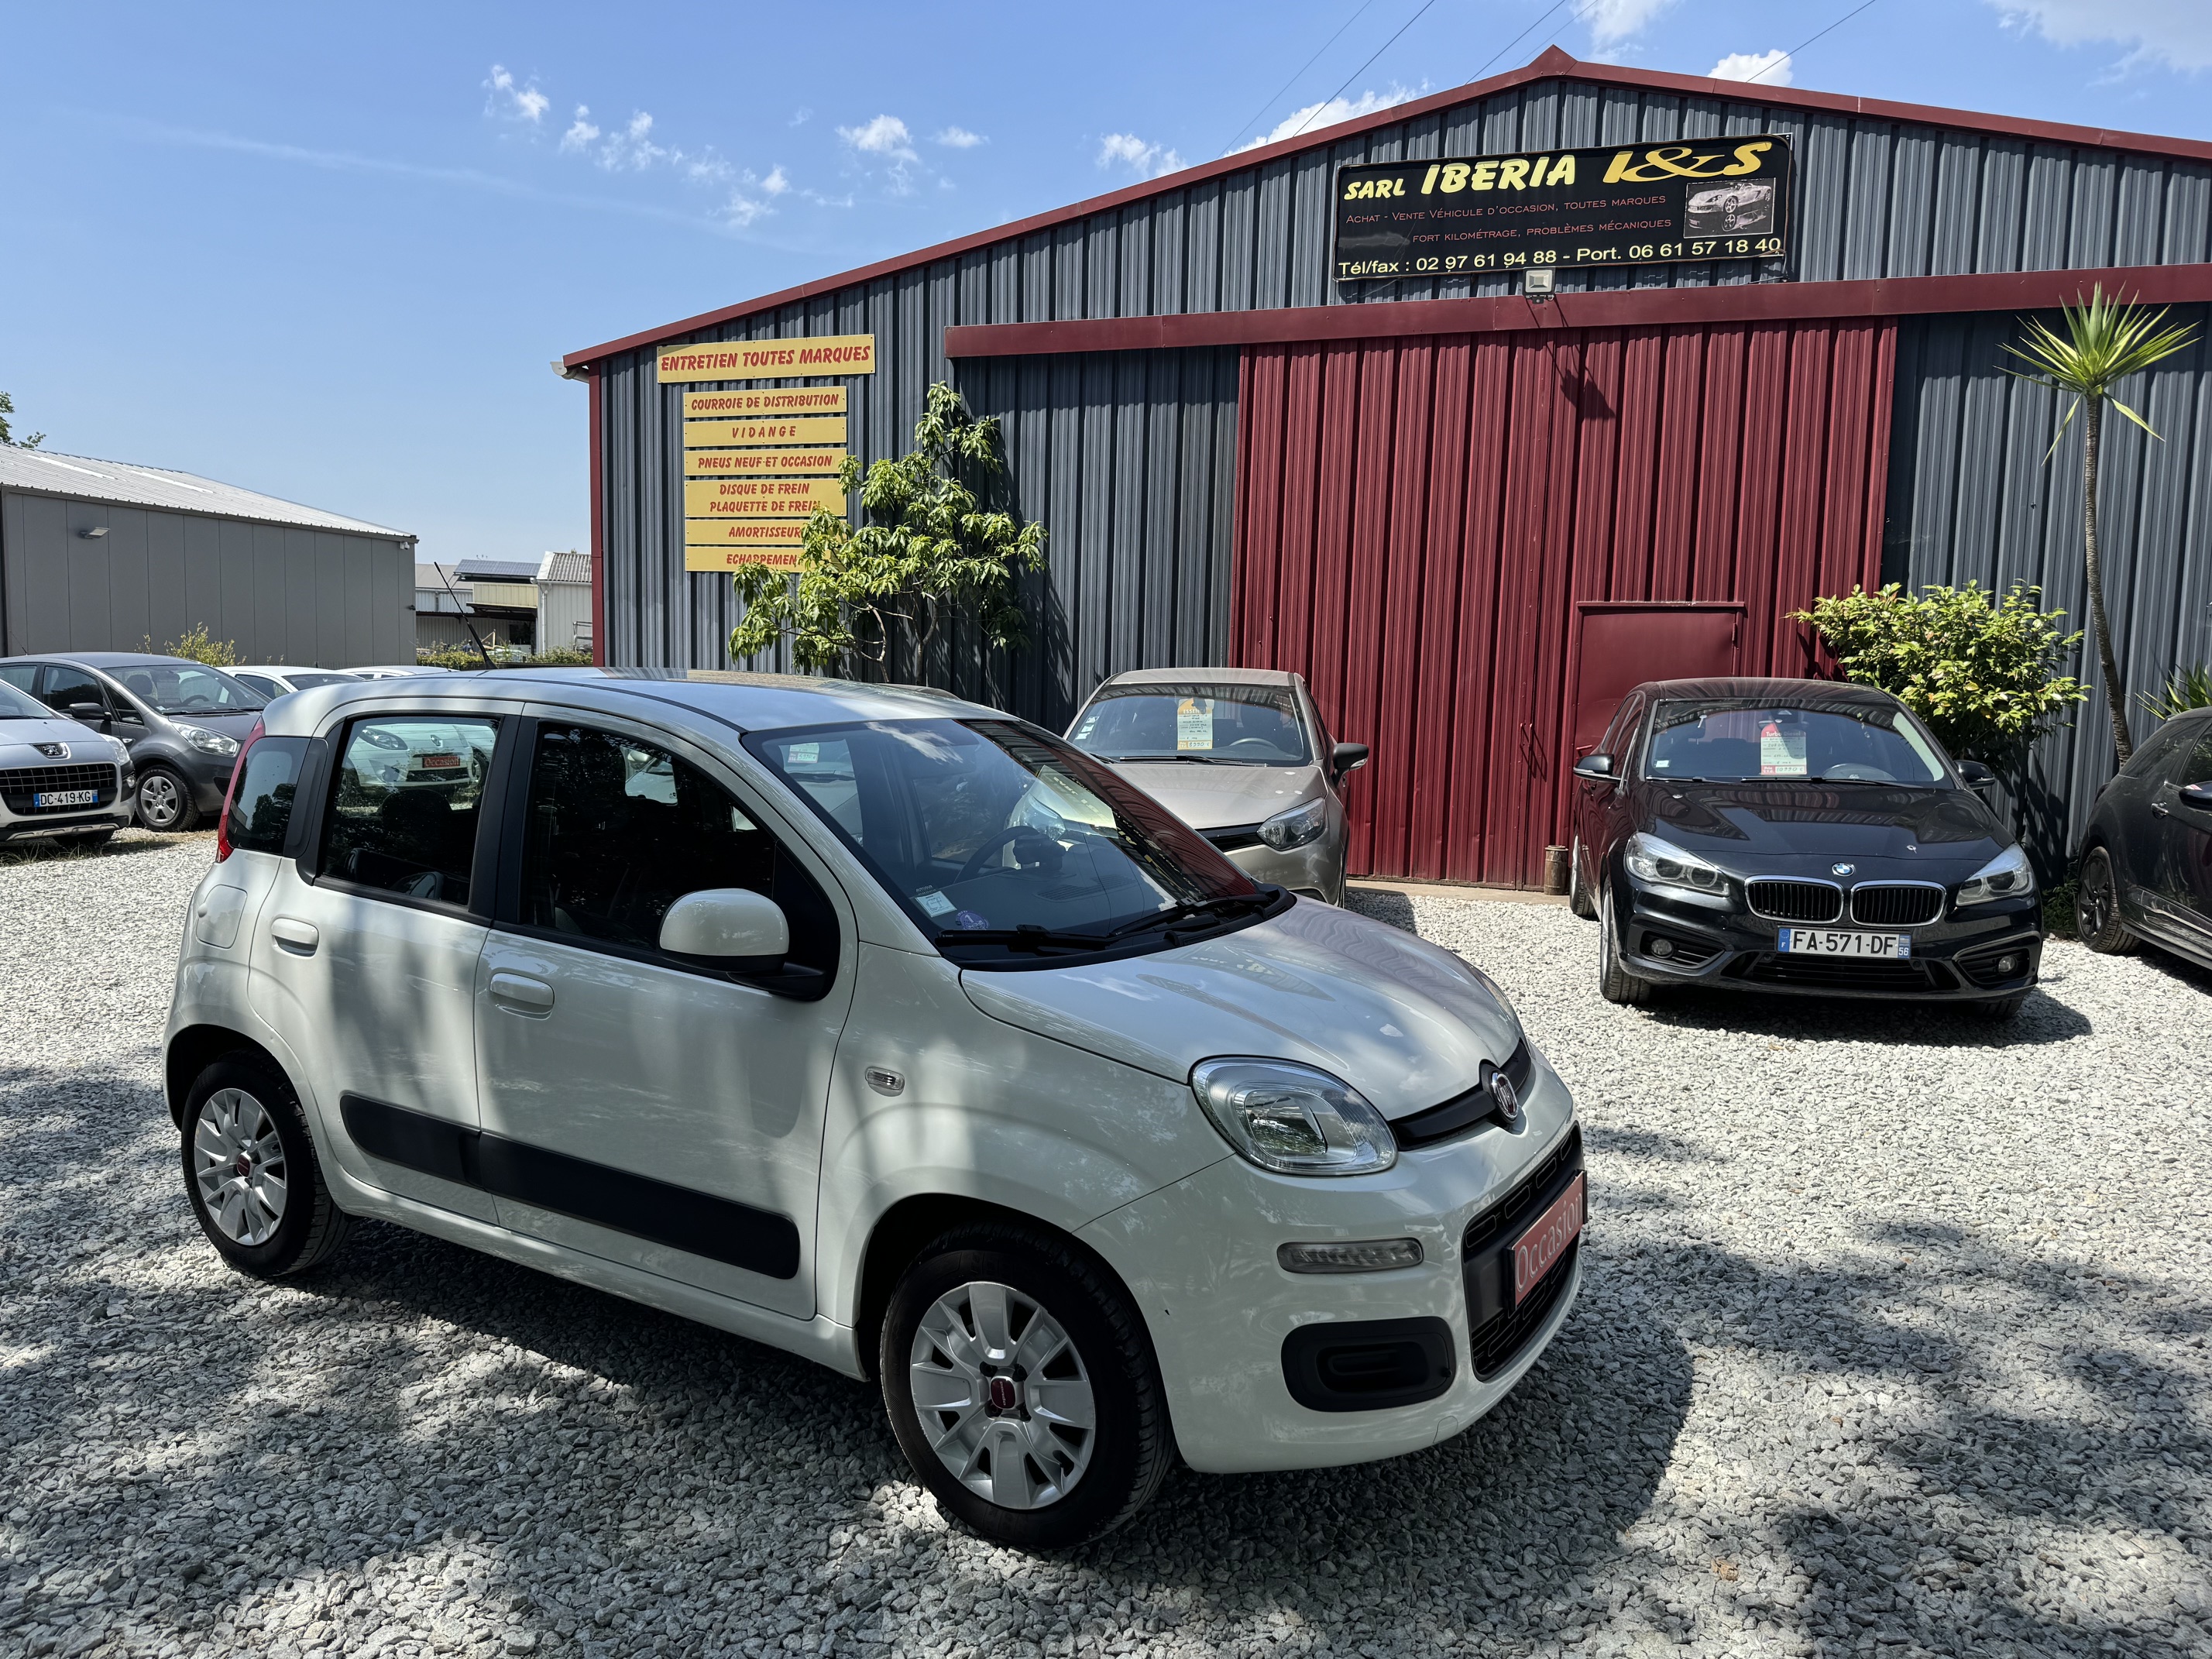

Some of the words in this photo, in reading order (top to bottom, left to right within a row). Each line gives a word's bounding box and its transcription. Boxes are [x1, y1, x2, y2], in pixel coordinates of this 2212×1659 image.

[1344, 178, 1406, 201] SARL
[1420, 154, 1575, 194] IBERIA
[1392, 211, 1425, 222] VENTE
[1429, 208, 1483, 219] VÉHICULE
[1564, 199, 1606, 210] TOUTES
[1612, 195, 1666, 206] MARQUES
[1413, 234, 1441, 243] FORT
[1444, 228, 1521, 242] KILOMÉTRAGE,
[1527, 222, 1594, 236] PROBLÈMES
[1599, 219, 1671, 231] MÉCANIQUES
[1338, 259, 1399, 275] Tél/fax
[1416, 257, 1439, 271] 02
[1444, 255, 1468, 270] 97
[1473, 252, 1495, 268] 61
[1503, 252, 1527, 266] 94
[1533, 249, 1557, 264] 88
[1577, 246, 1622, 262] Port.
[1629, 245, 1654, 259] 06
[1660, 242, 1682, 257] 61
[1692, 241, 1716, 256] 57
[1725, 239, 1749, 253] 18
[1754, 238, 1781, 252] 40
[661, 352, 738, 372] ENTRETIEN
[742, 349, 795, 367] TOUTES
[799, 345, 871, 365] MARQUES
[691, 397, 743, 410] COURROIE
[746, 397, 761, 408] DE
[763, 393, 839, 407] DISTRIBUTION
[698, 457, 733, 469] PNEUS
[734, 456, 763, 468] NEUF
[765, 456, 778, 468] ET
[781, 455, 833, 468] OCCASION
[720, 484, 757, 496] DISQUE
[761, 483, 775, 495] DE
[778, 483, 810, 495] FREIN
[709, 501, 768, 513] PLAQUETTE
[771, 500, 785, 512] DE
[425, 756, 459, 767] Occasion
[40, 791, 91, 805] DC-419-KG
[1792, 931, 1897, 955] FA-571-DF
[1898, 947, 1909, 957] 56
[1516, 1191, 1584, 1293] Occasion
